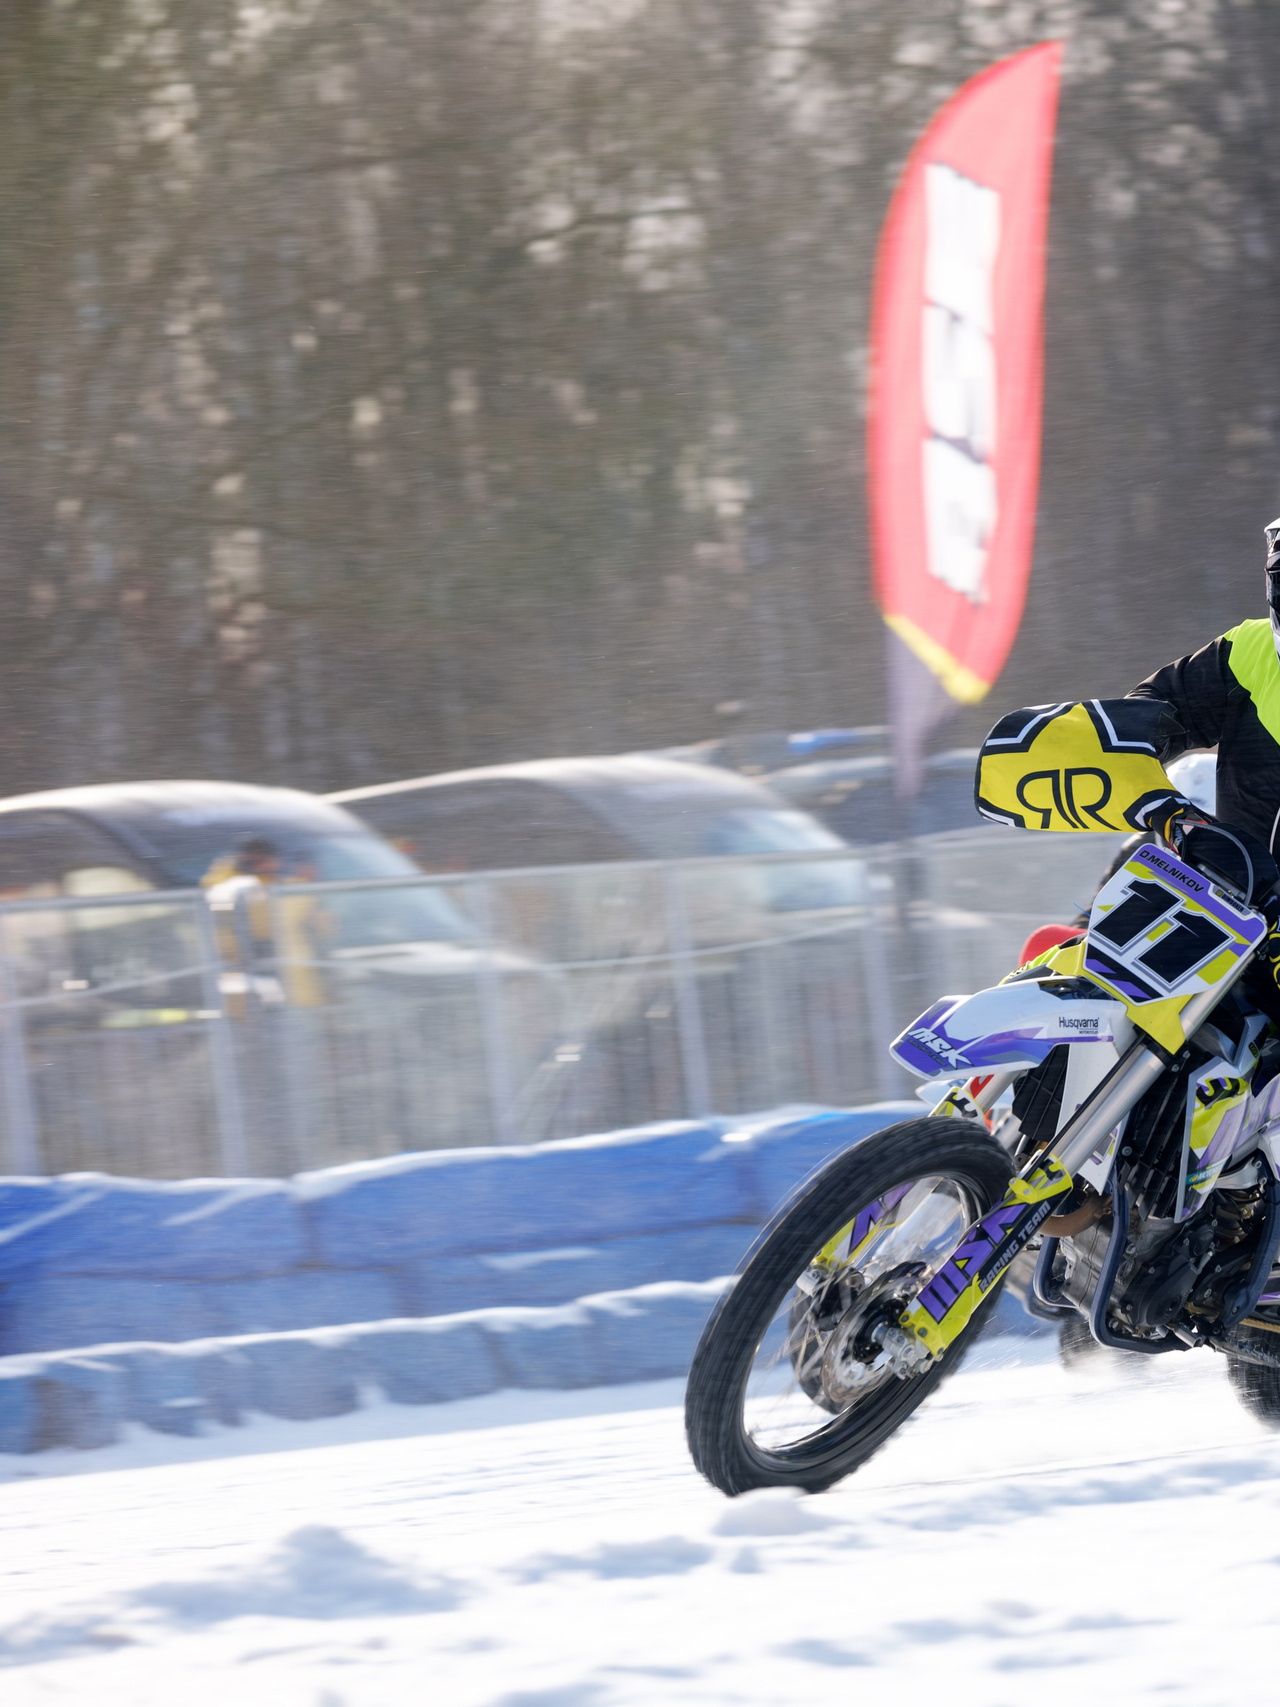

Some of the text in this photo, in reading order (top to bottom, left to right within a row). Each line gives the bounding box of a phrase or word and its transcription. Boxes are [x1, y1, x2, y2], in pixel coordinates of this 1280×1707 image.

[1139, 849, 1204, 893] D.MELNIKOV
[1091, 878, 1232, 985] 11
[1059, 1016, 1099, 1030] Husqvarna
[906, 1027, 974, 1070] MSK
[979, 1201, 1052, 1294] RACING TEAM
